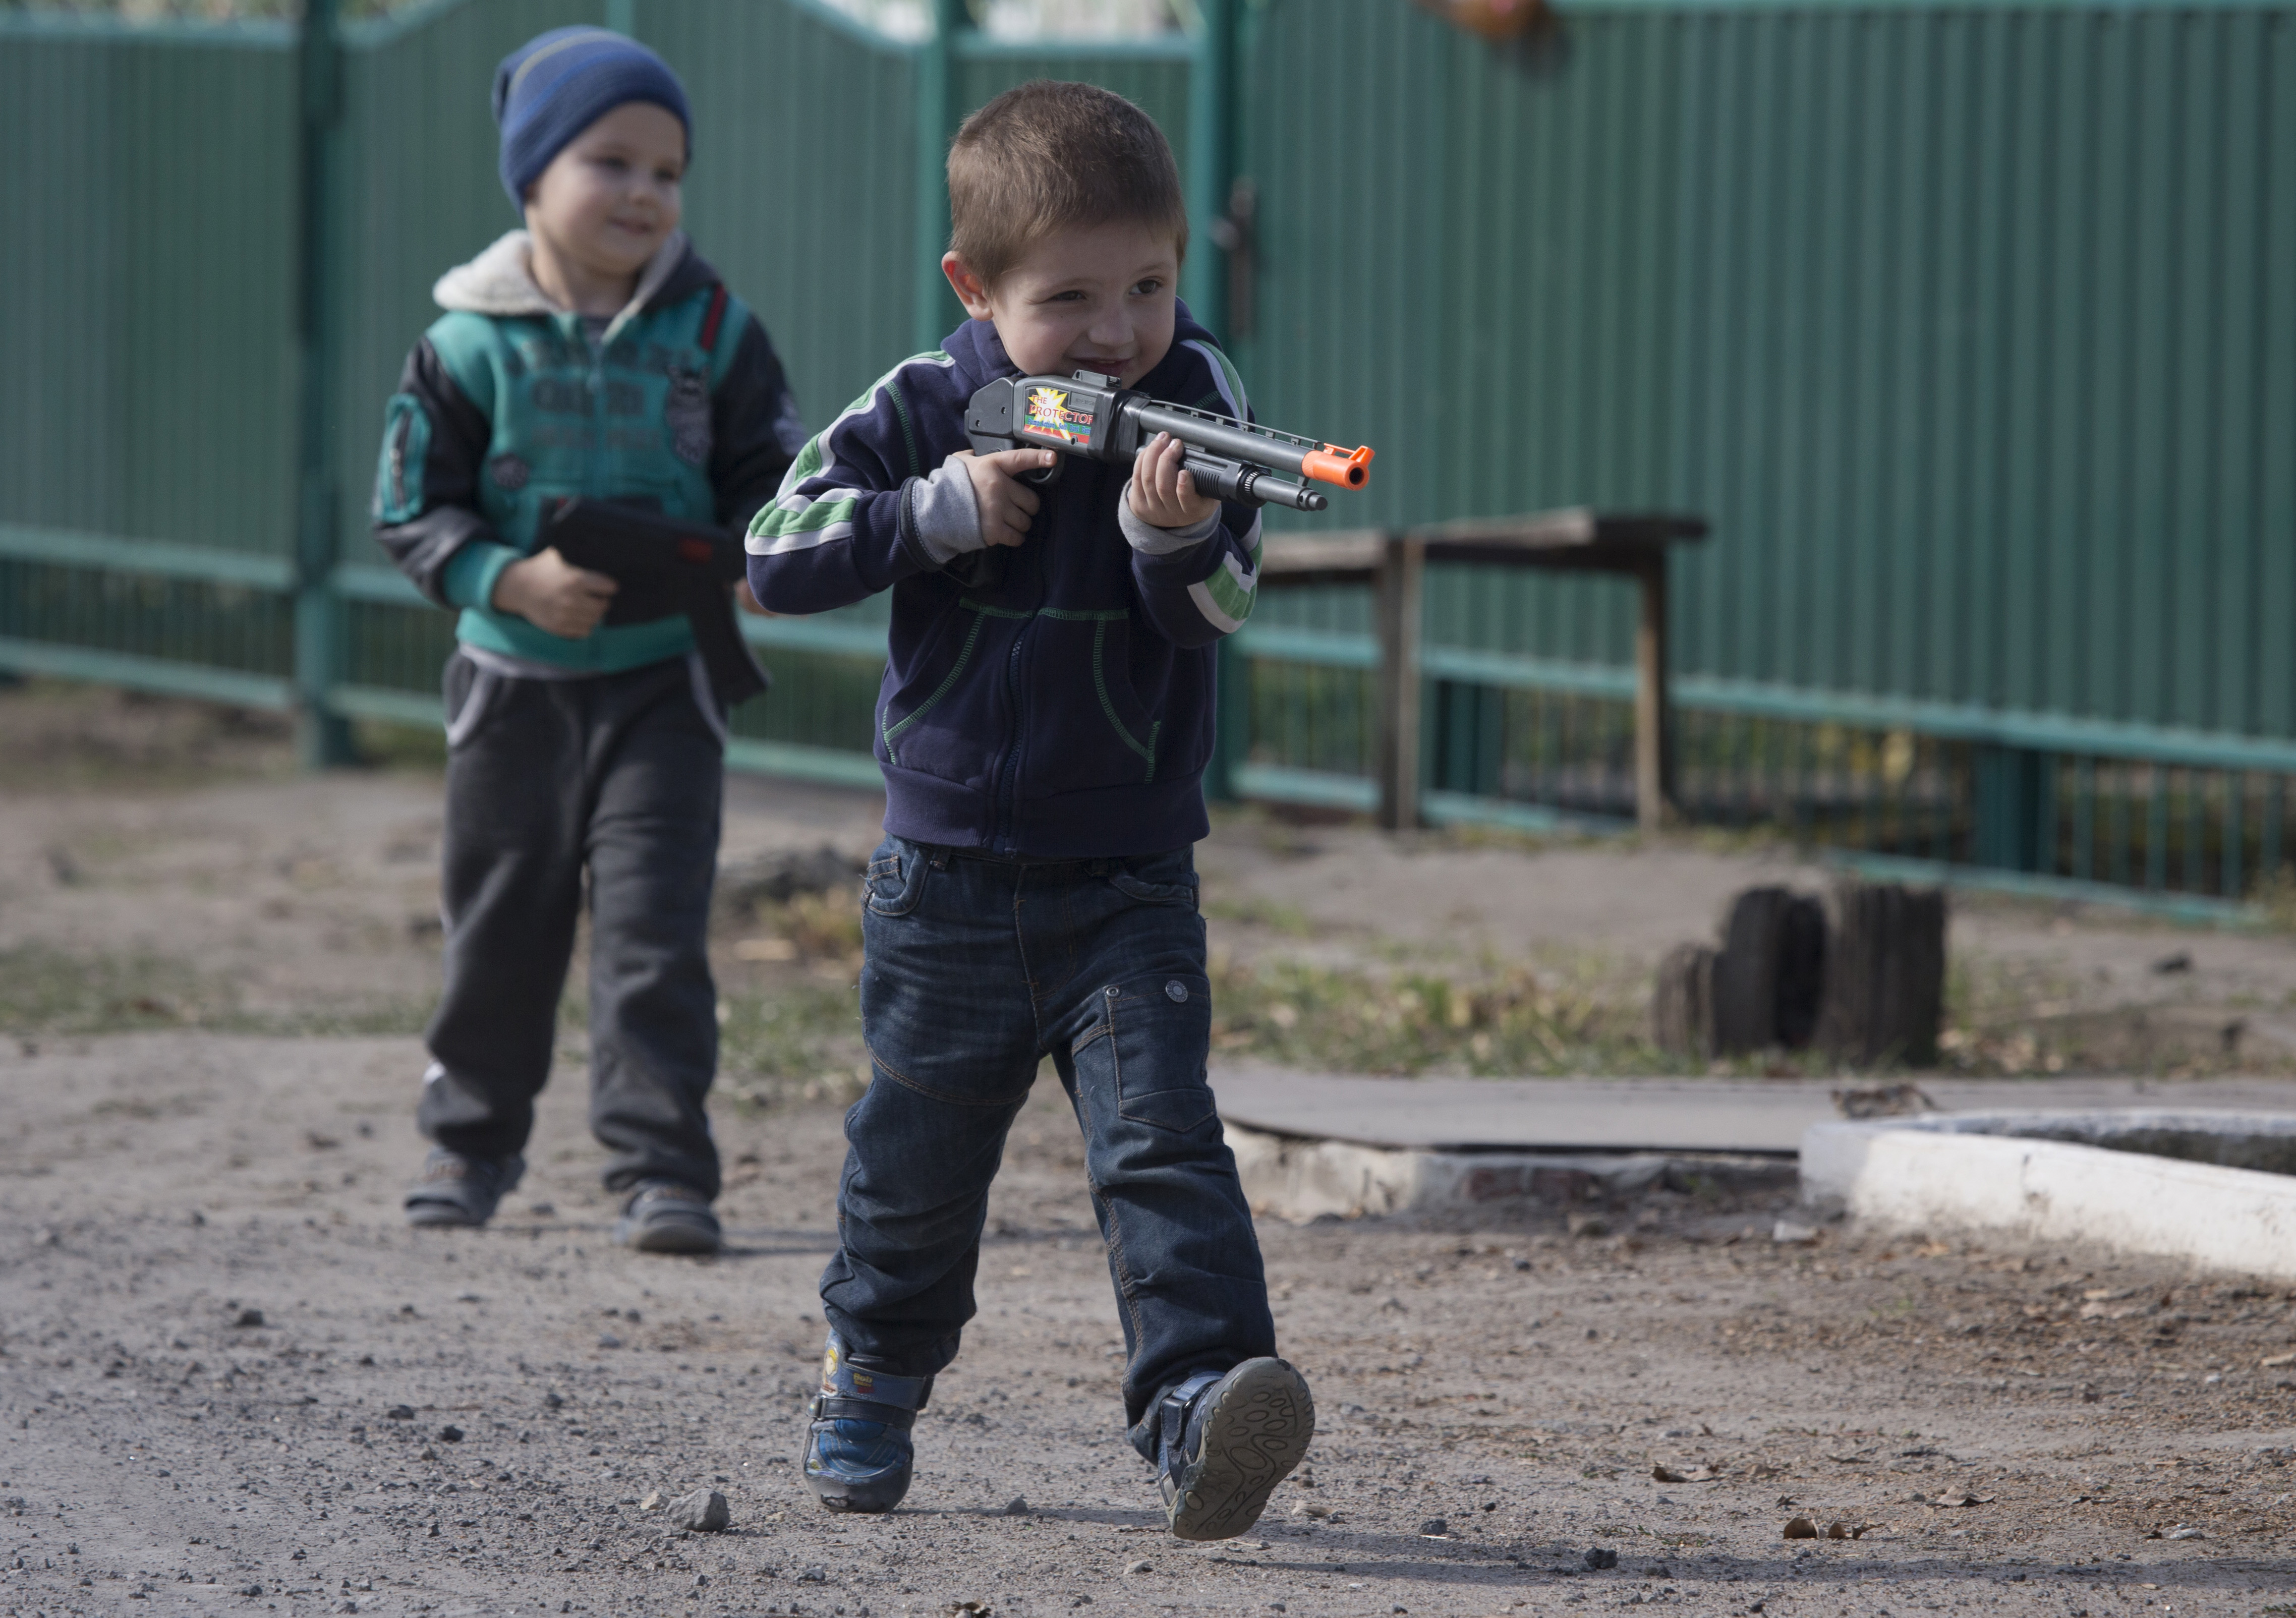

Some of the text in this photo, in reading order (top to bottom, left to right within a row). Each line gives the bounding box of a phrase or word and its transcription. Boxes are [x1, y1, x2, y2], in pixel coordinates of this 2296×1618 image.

[1031, 394, 1047, 404] THE
[1028, 418, 1040, 427] Pump
[1042, 420, 1055, 428] Action
[1069, 424, 1079, 432] Dart
[854, 1373, 872, 1382] Bob
